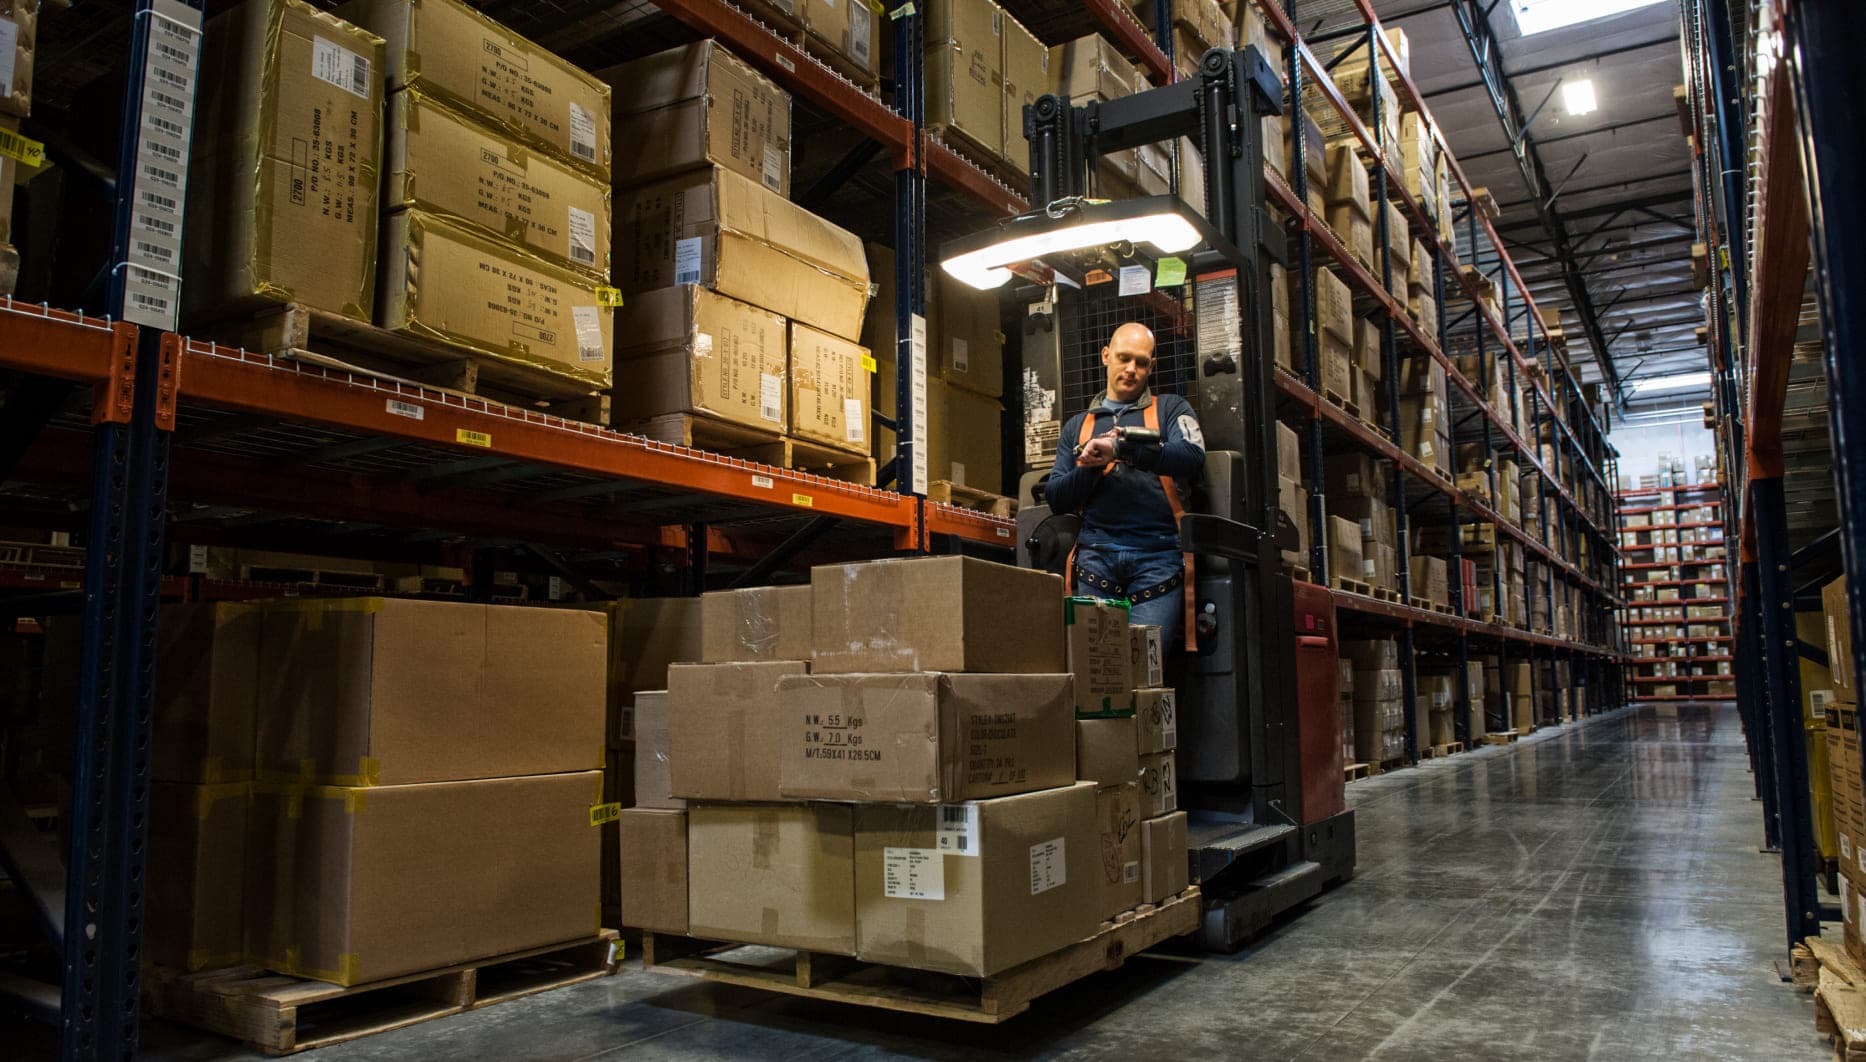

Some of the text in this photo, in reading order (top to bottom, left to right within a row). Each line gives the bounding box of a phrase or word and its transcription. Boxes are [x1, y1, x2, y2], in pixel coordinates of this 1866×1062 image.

[351, 110, 358, 126] CM
[293, 178, 303, 201] 2700
[847, 715, 863, 729] Kgs
[847, 733, 863, 747] Kgs
